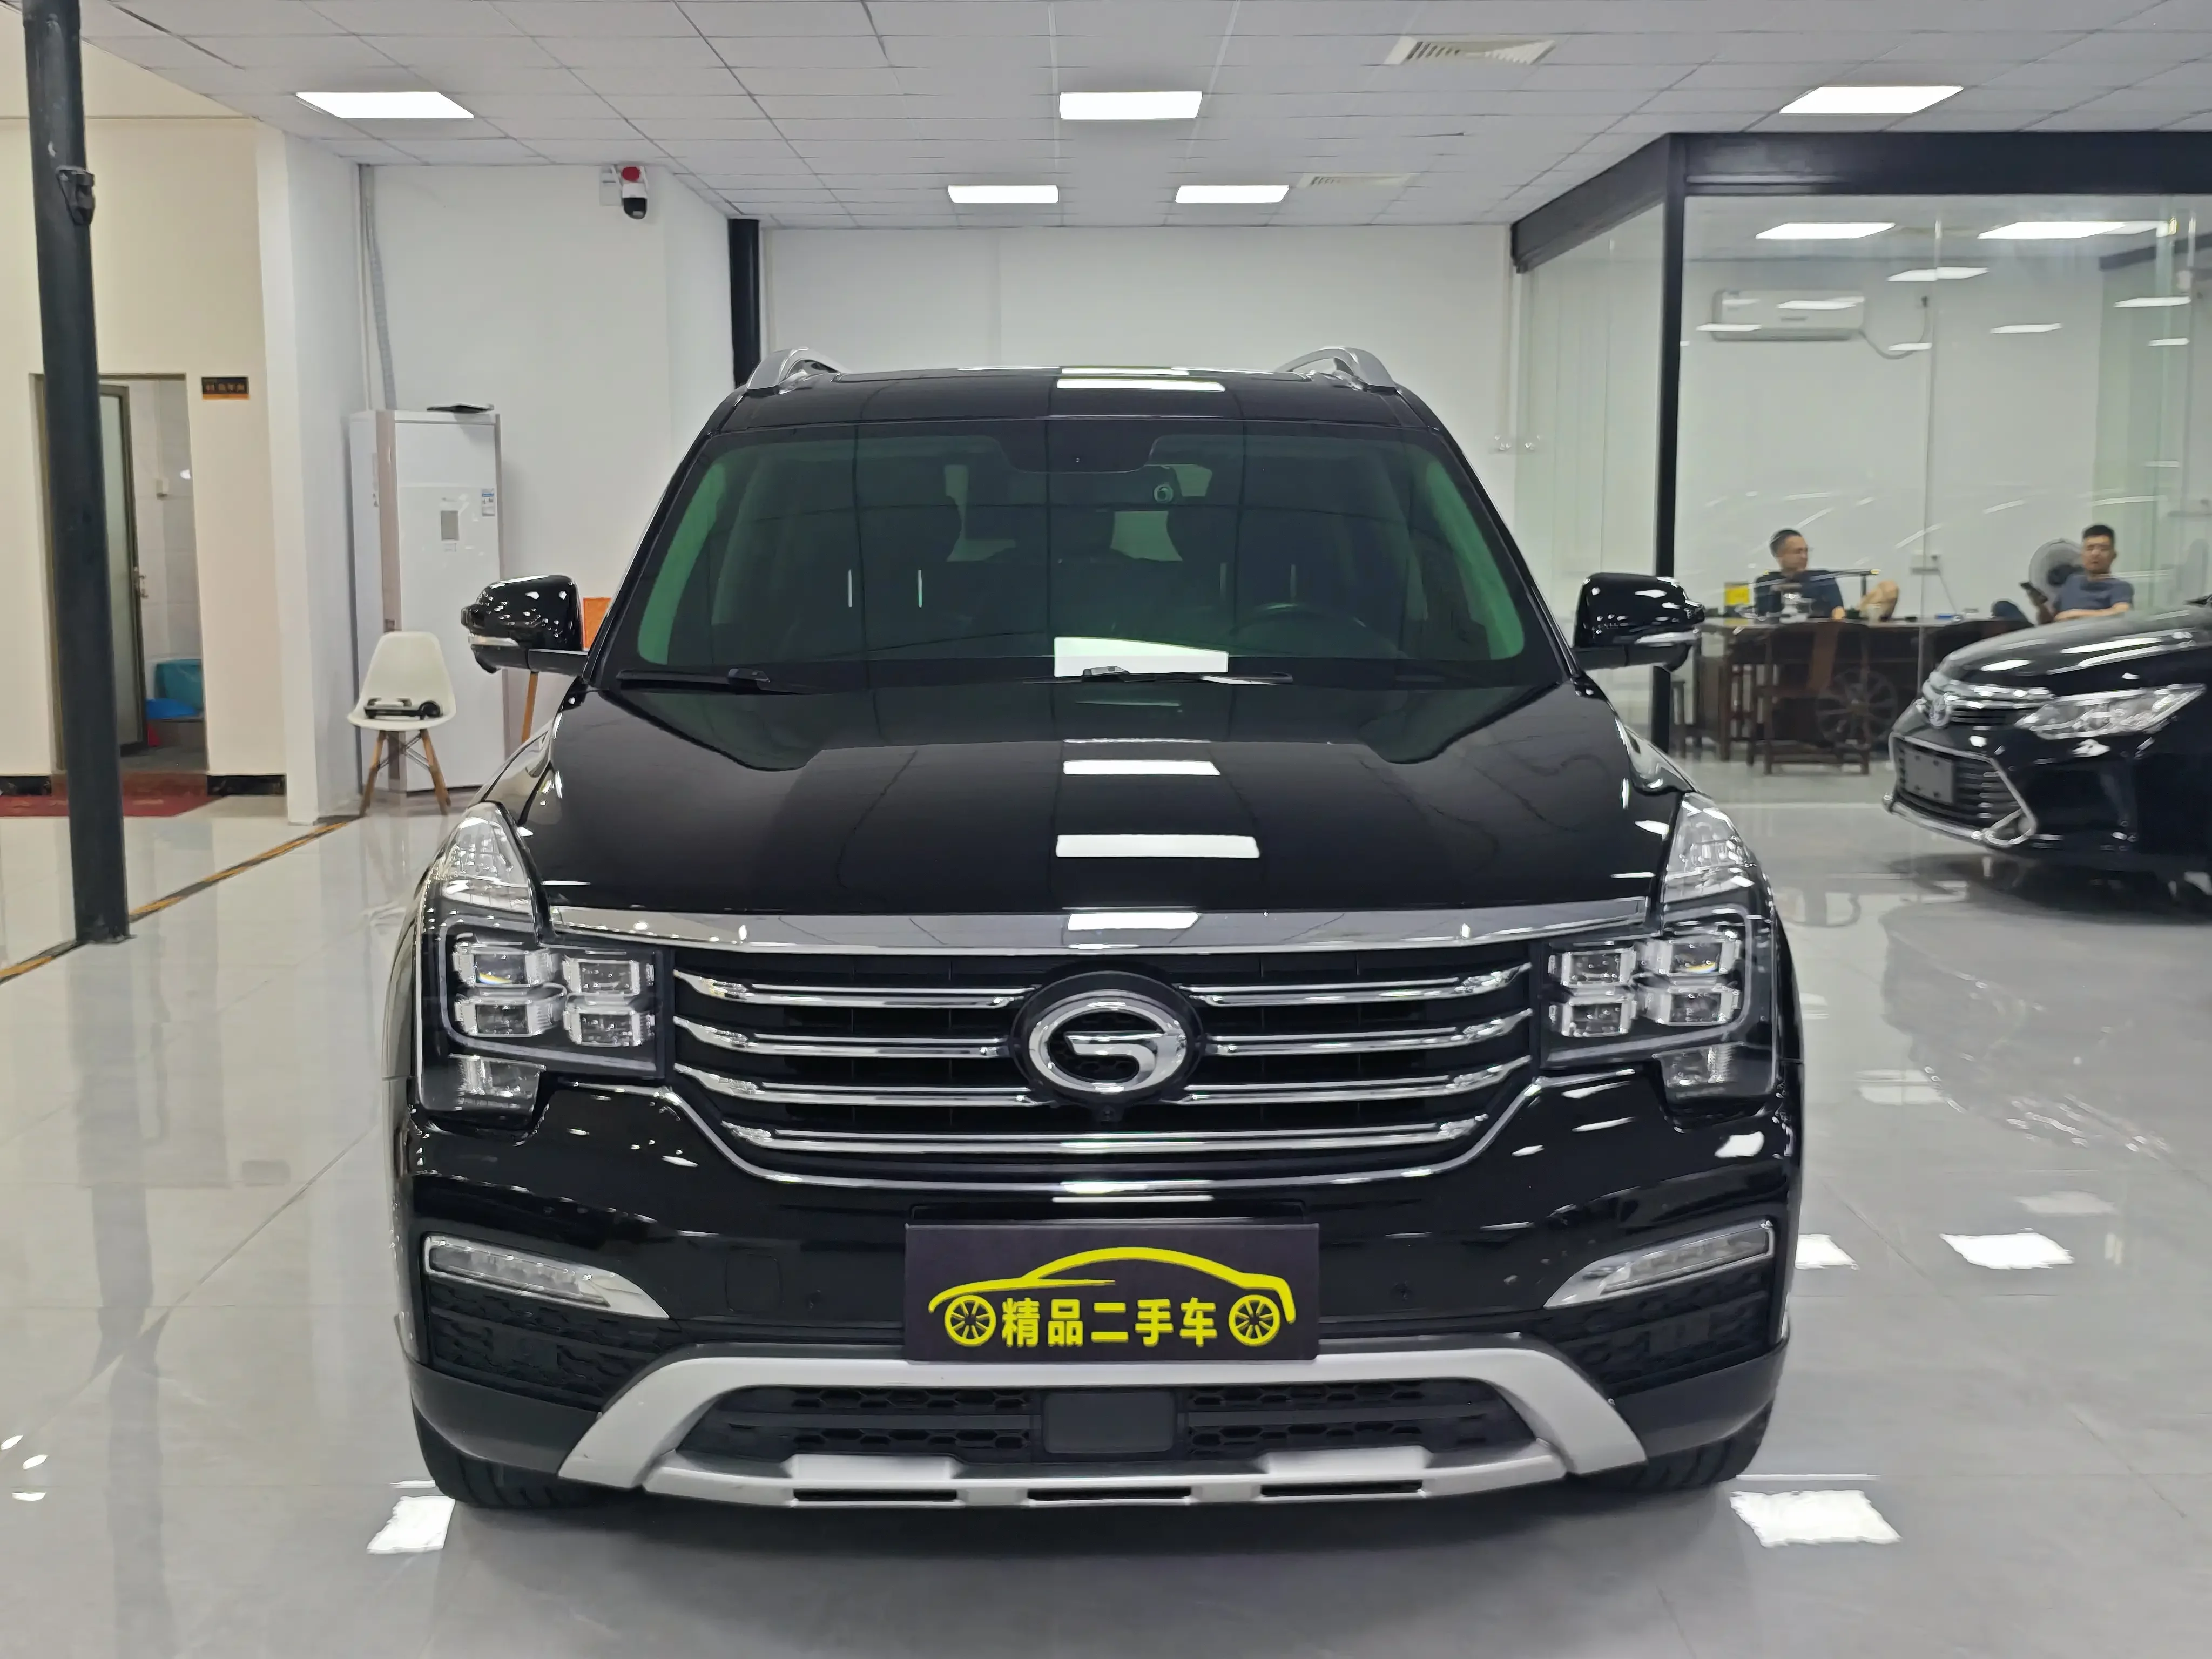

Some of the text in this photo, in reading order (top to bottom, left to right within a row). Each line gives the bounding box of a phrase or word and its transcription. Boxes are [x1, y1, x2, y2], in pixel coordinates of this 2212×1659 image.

[1002, 1297, 1218, 1348] 精品二手车
